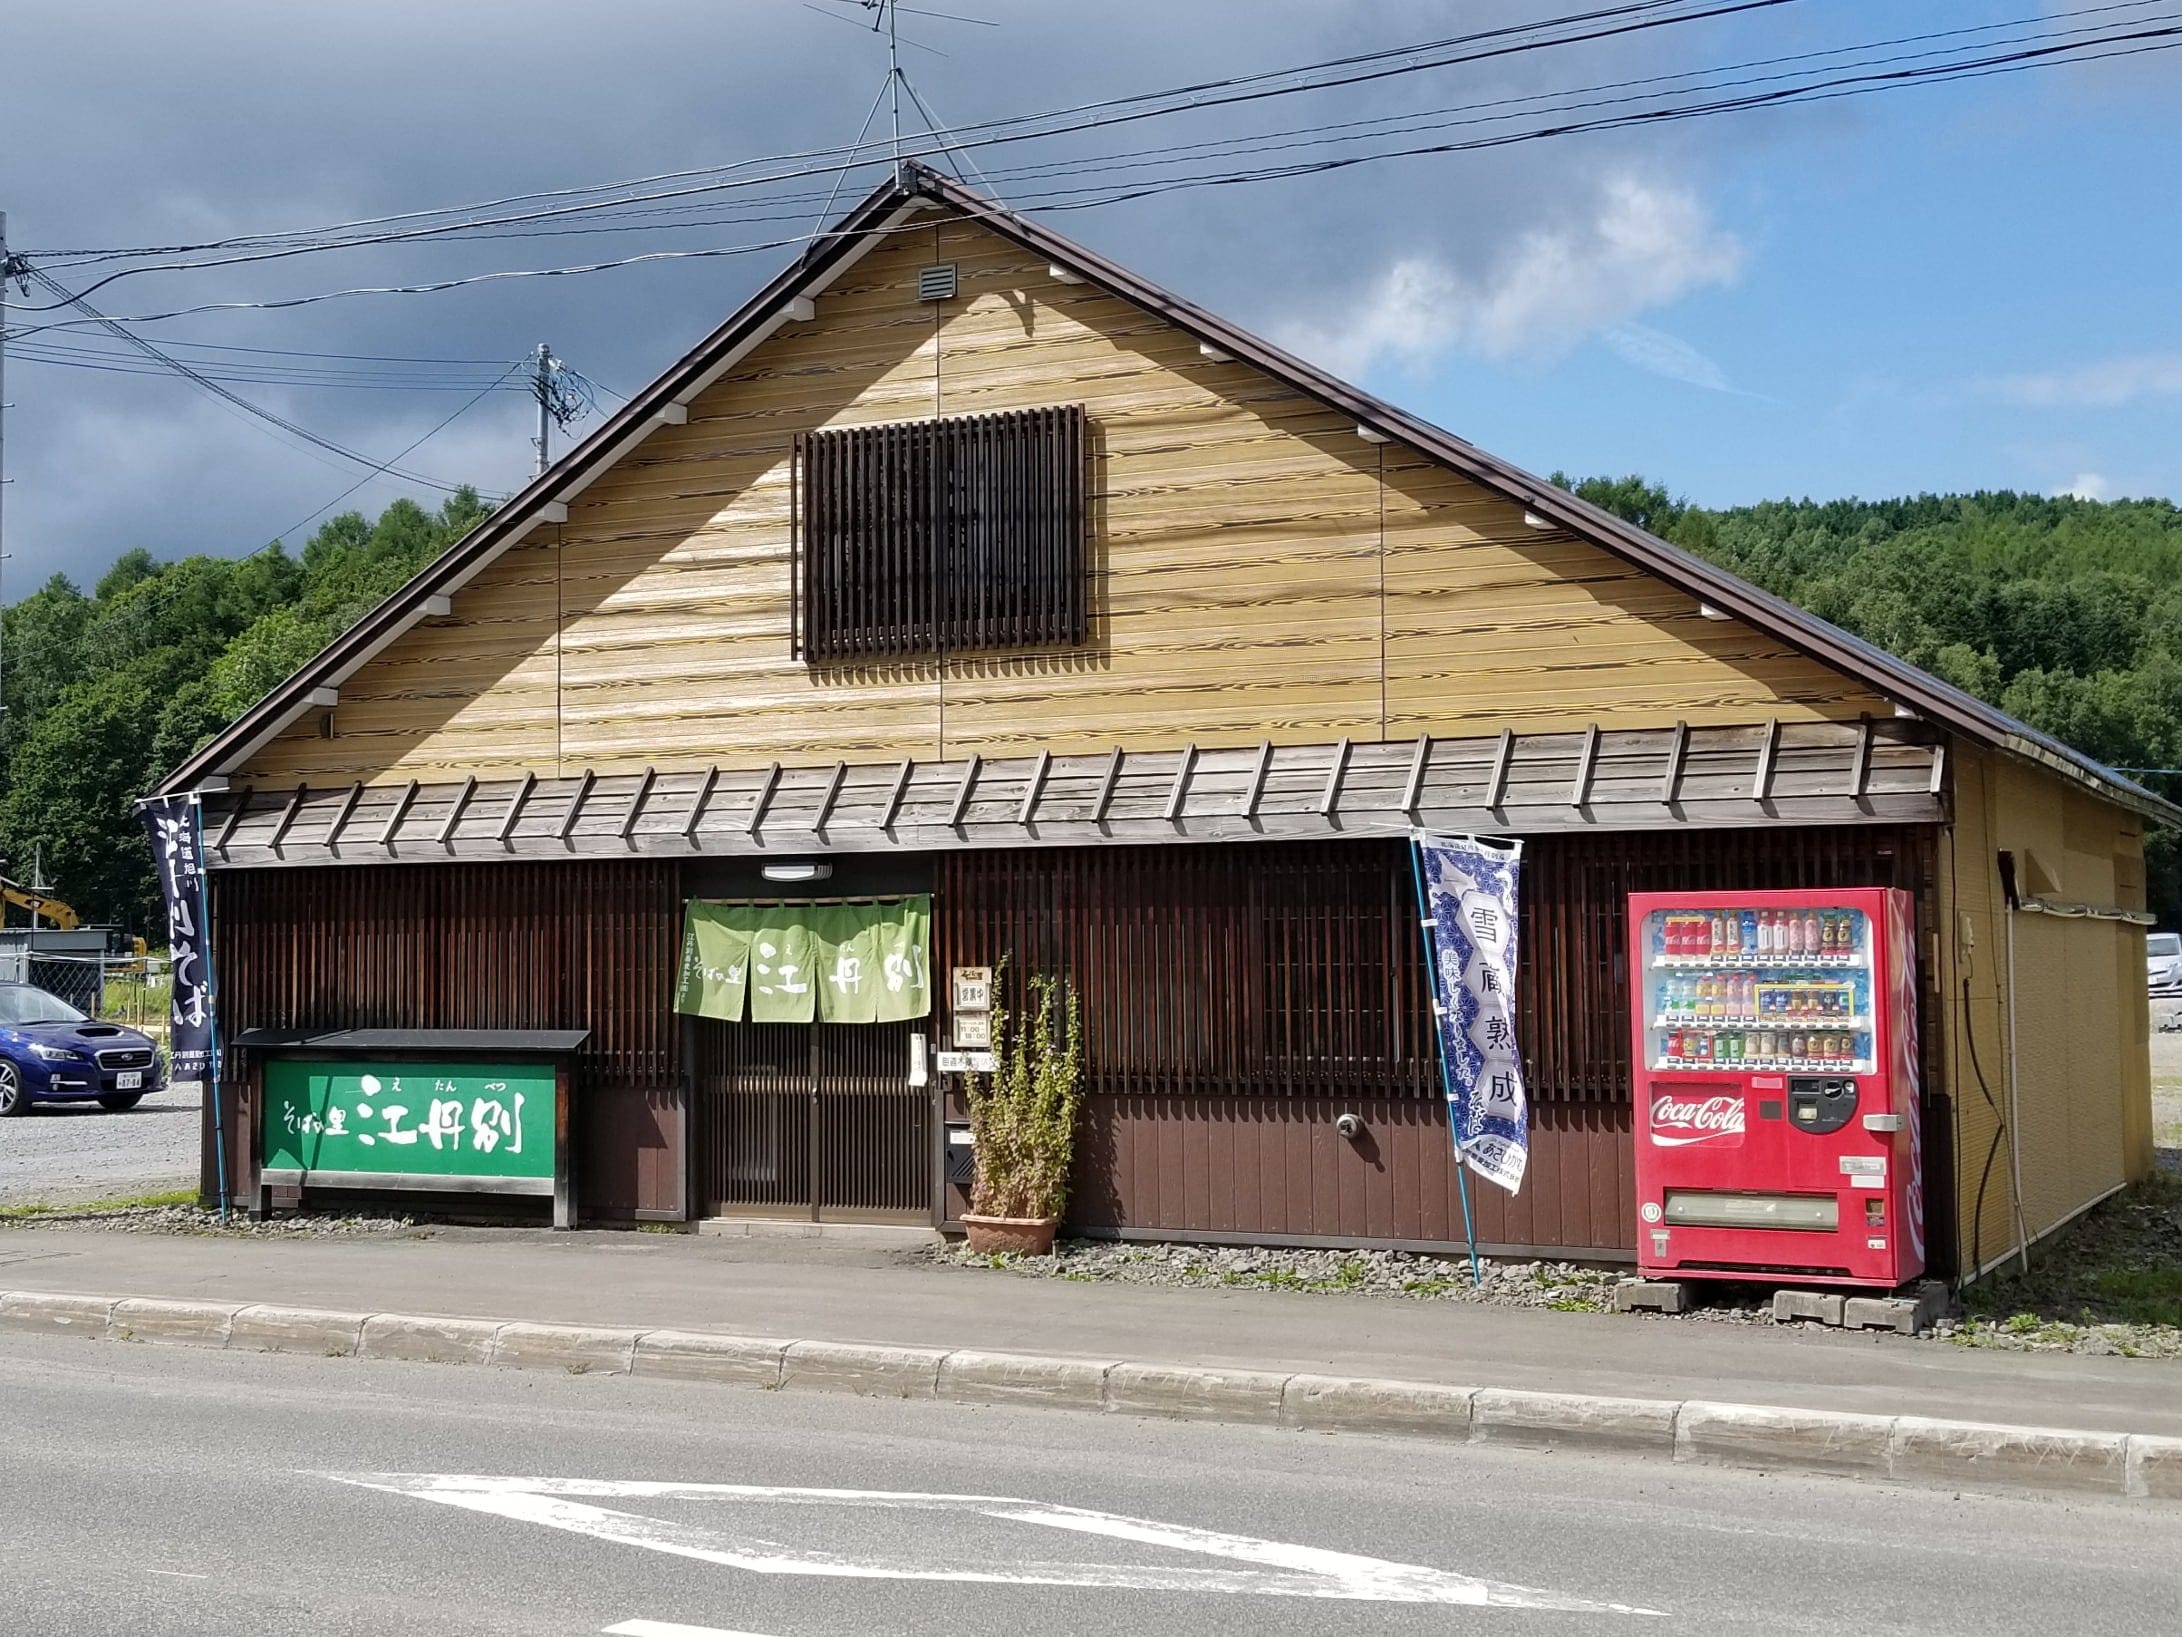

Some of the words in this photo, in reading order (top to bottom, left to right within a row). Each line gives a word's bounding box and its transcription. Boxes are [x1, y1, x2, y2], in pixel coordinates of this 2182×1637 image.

[757, 942, 924, 994] 江丹別
[1470, 907, 1518, 1107] 雪蔵熟成
[391, 1077, 402, 1092] え
[435, 1079, 457, 1092] たん
[484, 1081, 507, 1092] べつ
[283, 1100, 350, 1135] そばの里
[356, 1074, 526, 1154] 江丹別
[1468, 1090, 1486, 1136] そば
[1651, 1095, 1746, 1131] Coca-Cola
